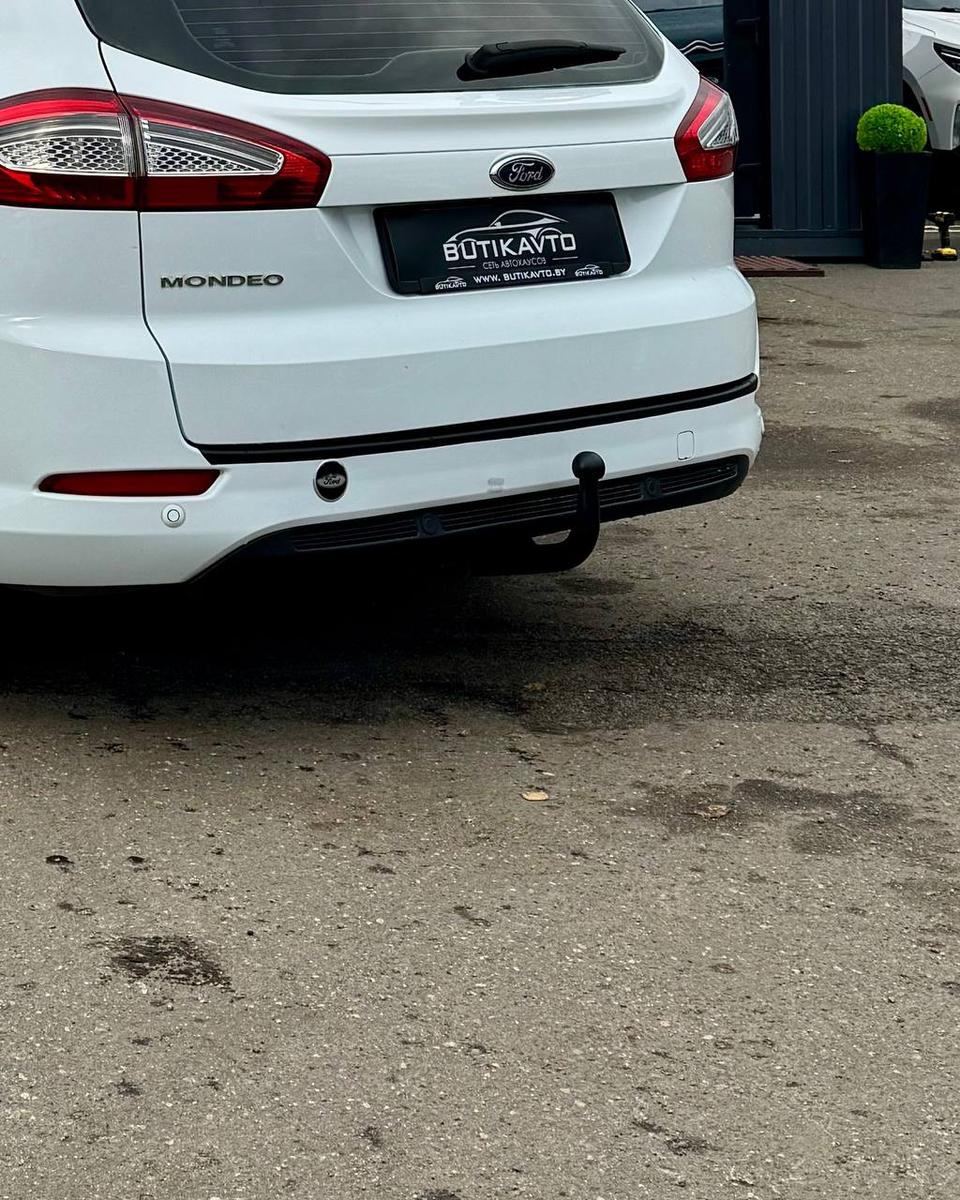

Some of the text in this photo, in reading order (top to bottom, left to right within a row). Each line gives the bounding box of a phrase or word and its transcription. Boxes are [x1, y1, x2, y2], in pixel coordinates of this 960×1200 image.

[508, 162, 544, 182] Ford
[442, 233, 577, 262] BUTIKAVTO
[482, 256, 547, 270] СЕТЬ АВТОХАУСОВ
[160, 274, 284, 289] MONDEO
[473, 268, 566, 284] WWW. BUTIKAVTO.BY
[323, 475, 342, 486] Ford
